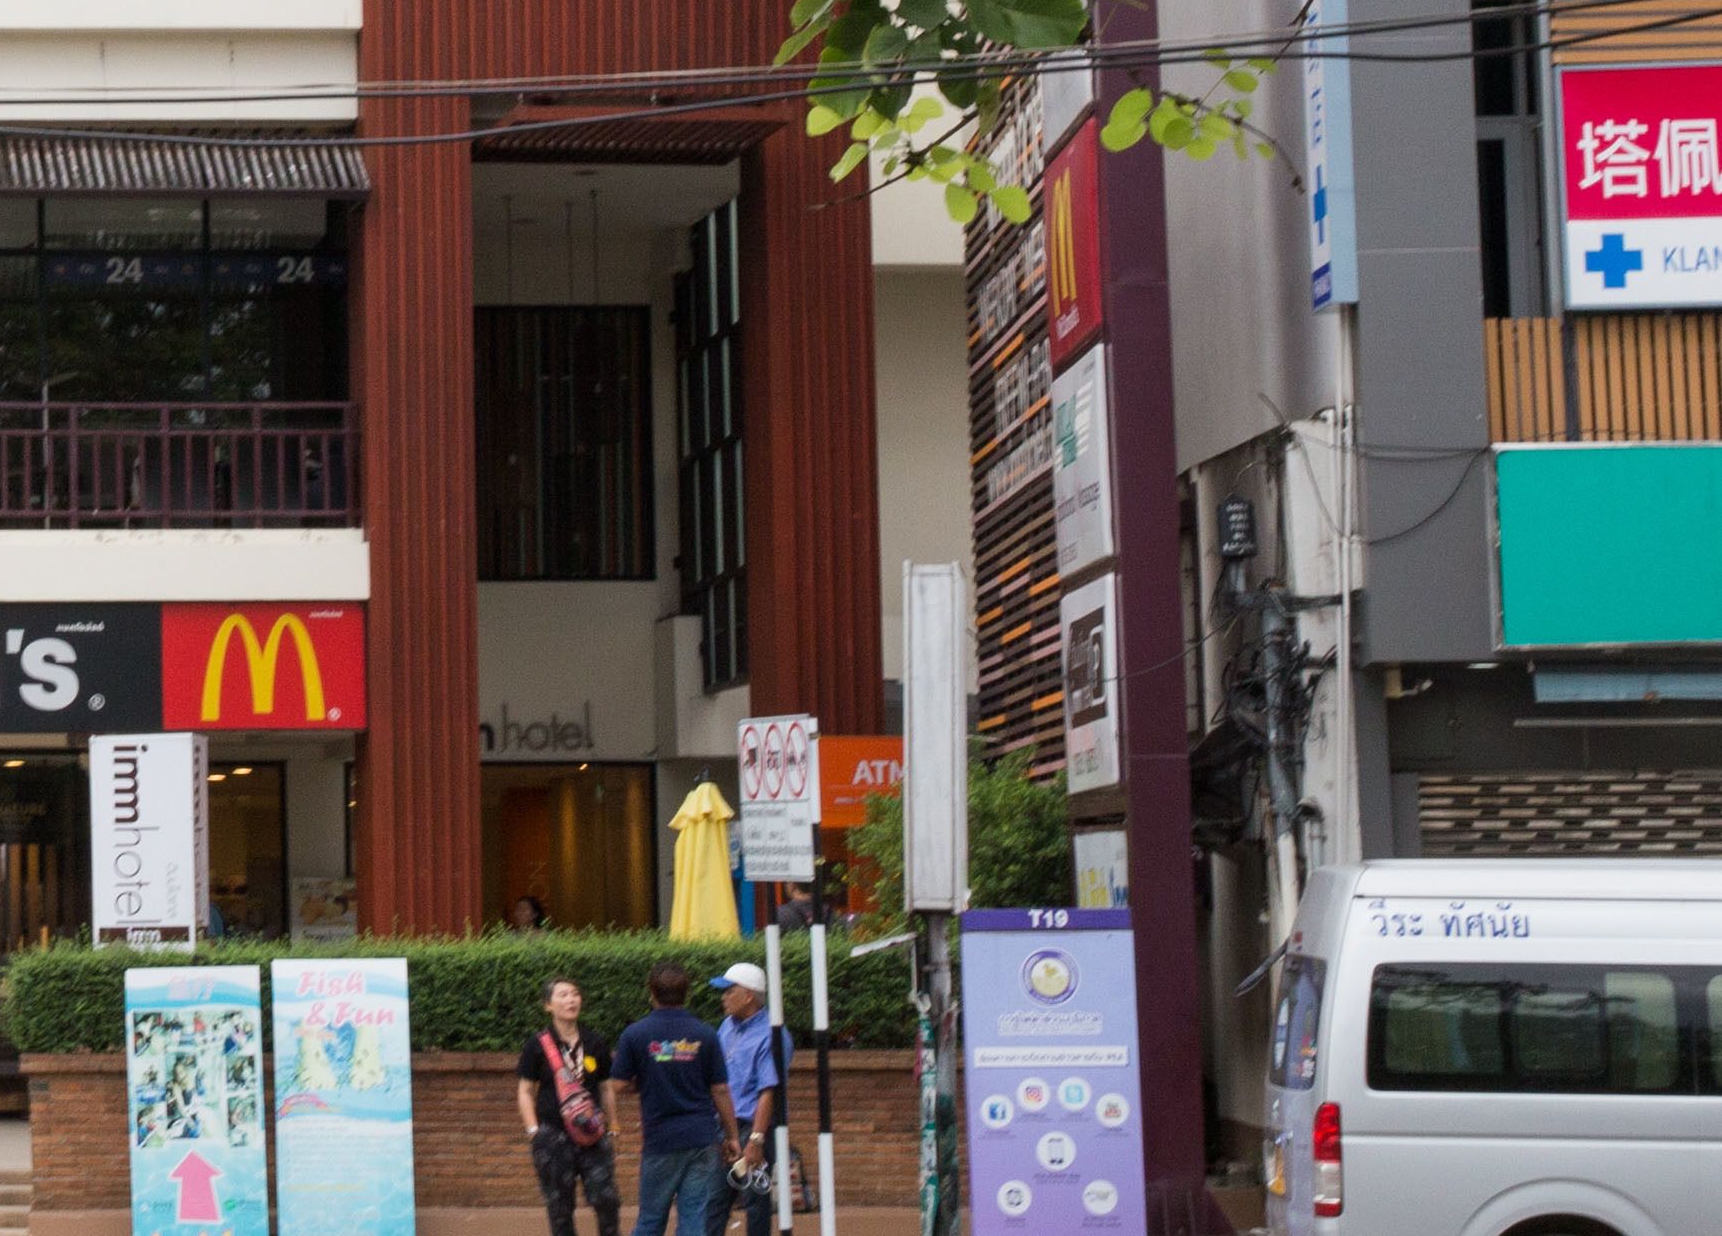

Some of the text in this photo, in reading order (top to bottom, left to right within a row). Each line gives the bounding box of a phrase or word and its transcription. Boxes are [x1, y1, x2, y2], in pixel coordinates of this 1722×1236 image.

[106, 256, 145, 284] 24
[278, 256, 316, 284] 24
[1028, 908, 1070, 929] T19
[296, 971, 365, 996] Fish
[333, 1002, 396, 1028] Fun
